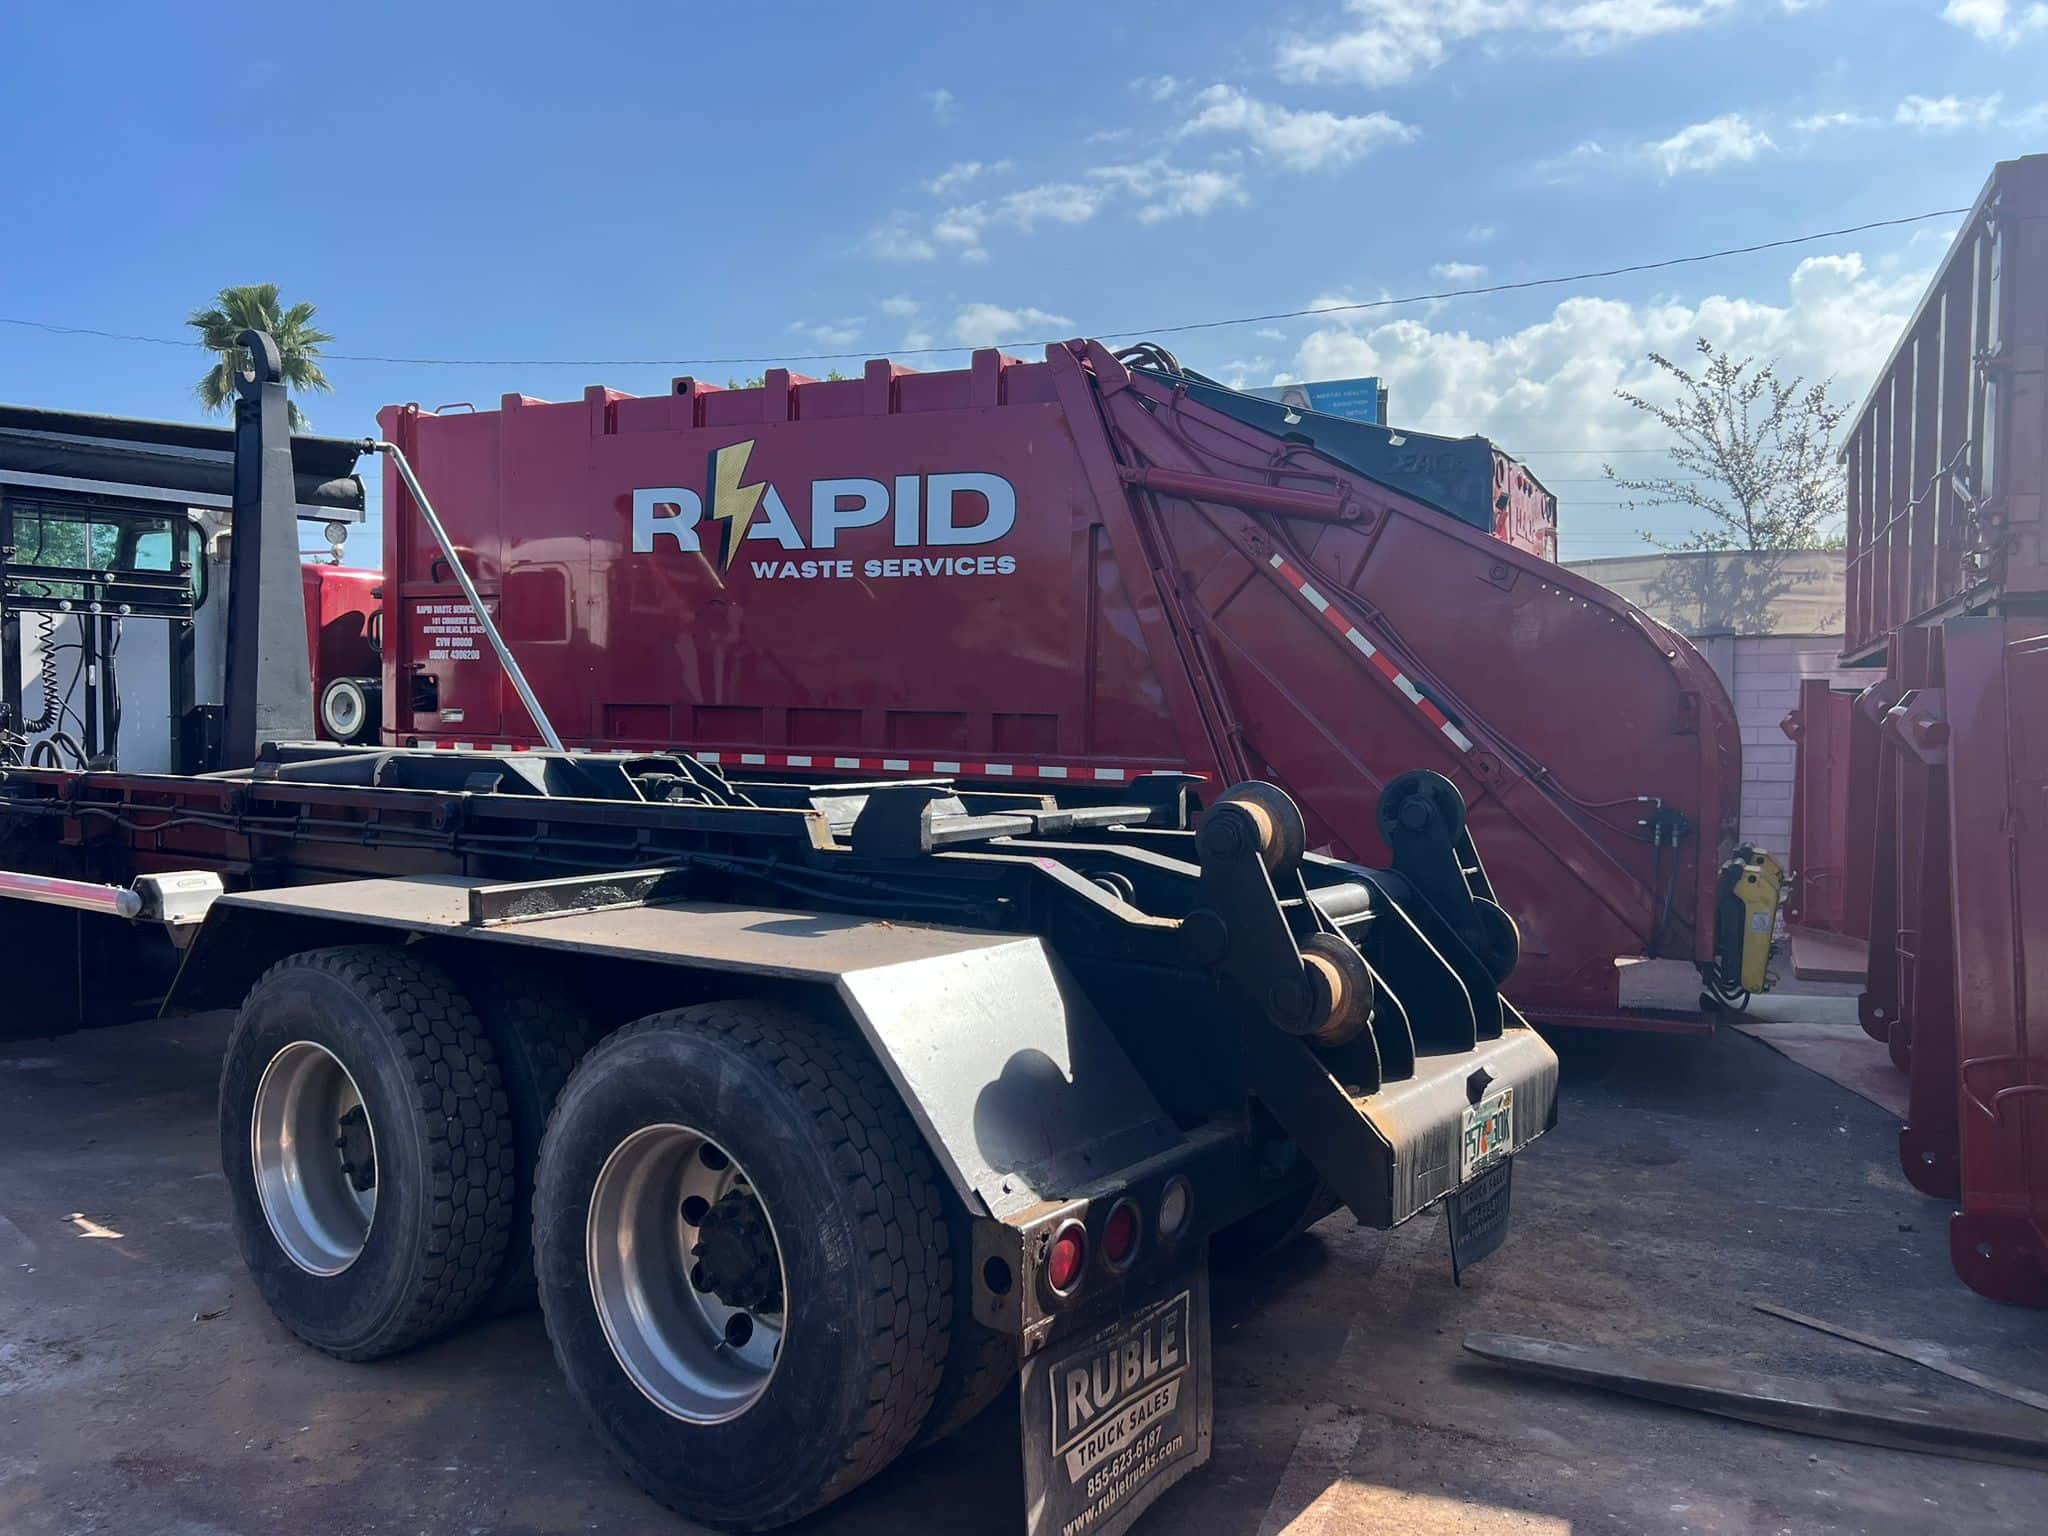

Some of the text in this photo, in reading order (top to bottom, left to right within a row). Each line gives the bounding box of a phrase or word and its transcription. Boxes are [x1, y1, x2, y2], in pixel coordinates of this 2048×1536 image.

[632, 472, 1016, 553] RAPID
[751, 556, 1016, 579] WASTE SERVICES
[453, 605, 476, 614] SERVICE
[1066, 1310, 1179, 1430] RUBLE
[1077, 1388, 1170, 1467] TRUCK SALES
[1086, 1425, 1163, 1498] 855-623-6187
[1062, 1434, 1184, 1536] www.rubletrucks.com
